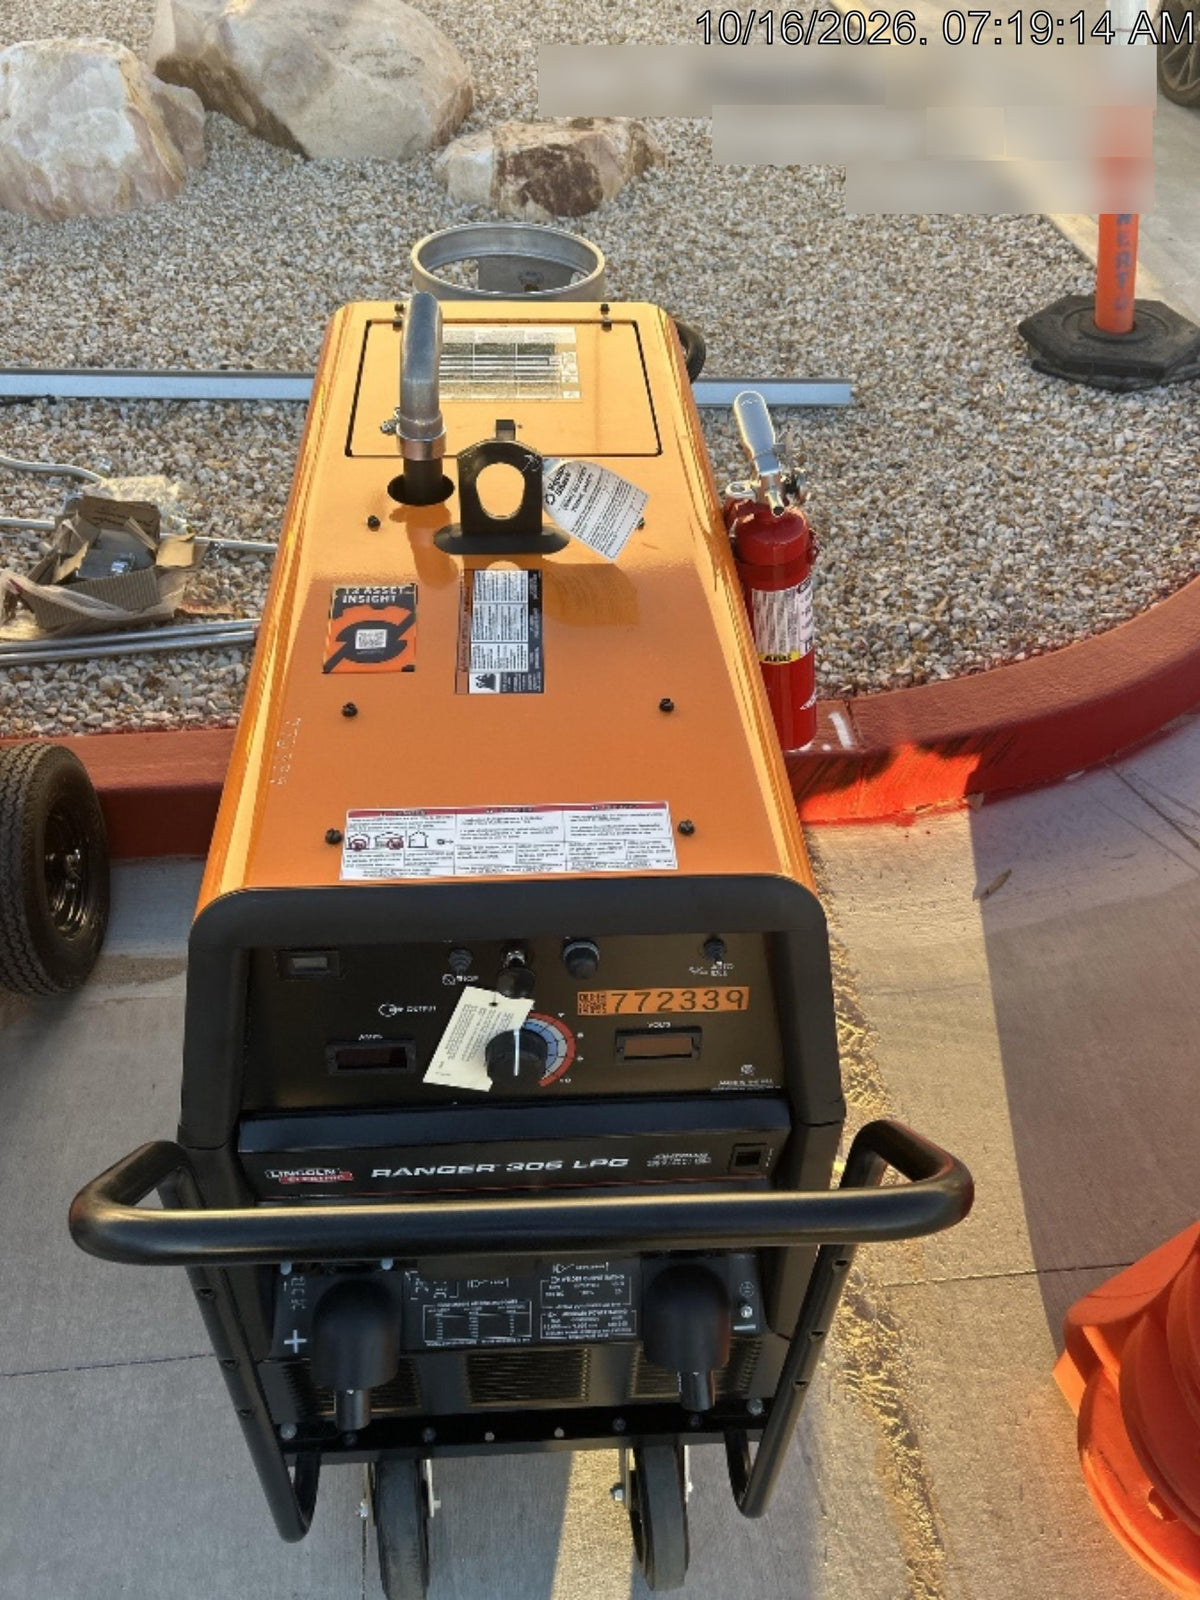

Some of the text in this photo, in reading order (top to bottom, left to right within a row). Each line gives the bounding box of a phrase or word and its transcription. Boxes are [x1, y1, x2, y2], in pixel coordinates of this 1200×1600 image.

[342, 595, 396, 604] INSIGHT
[611, 989, 744, 1012] 772339
[270, 1168, 338, 1179] LINCOLN
[371, 1162, 497, 1179] RANGER
[573, 1157, 630, 1170] LPG
